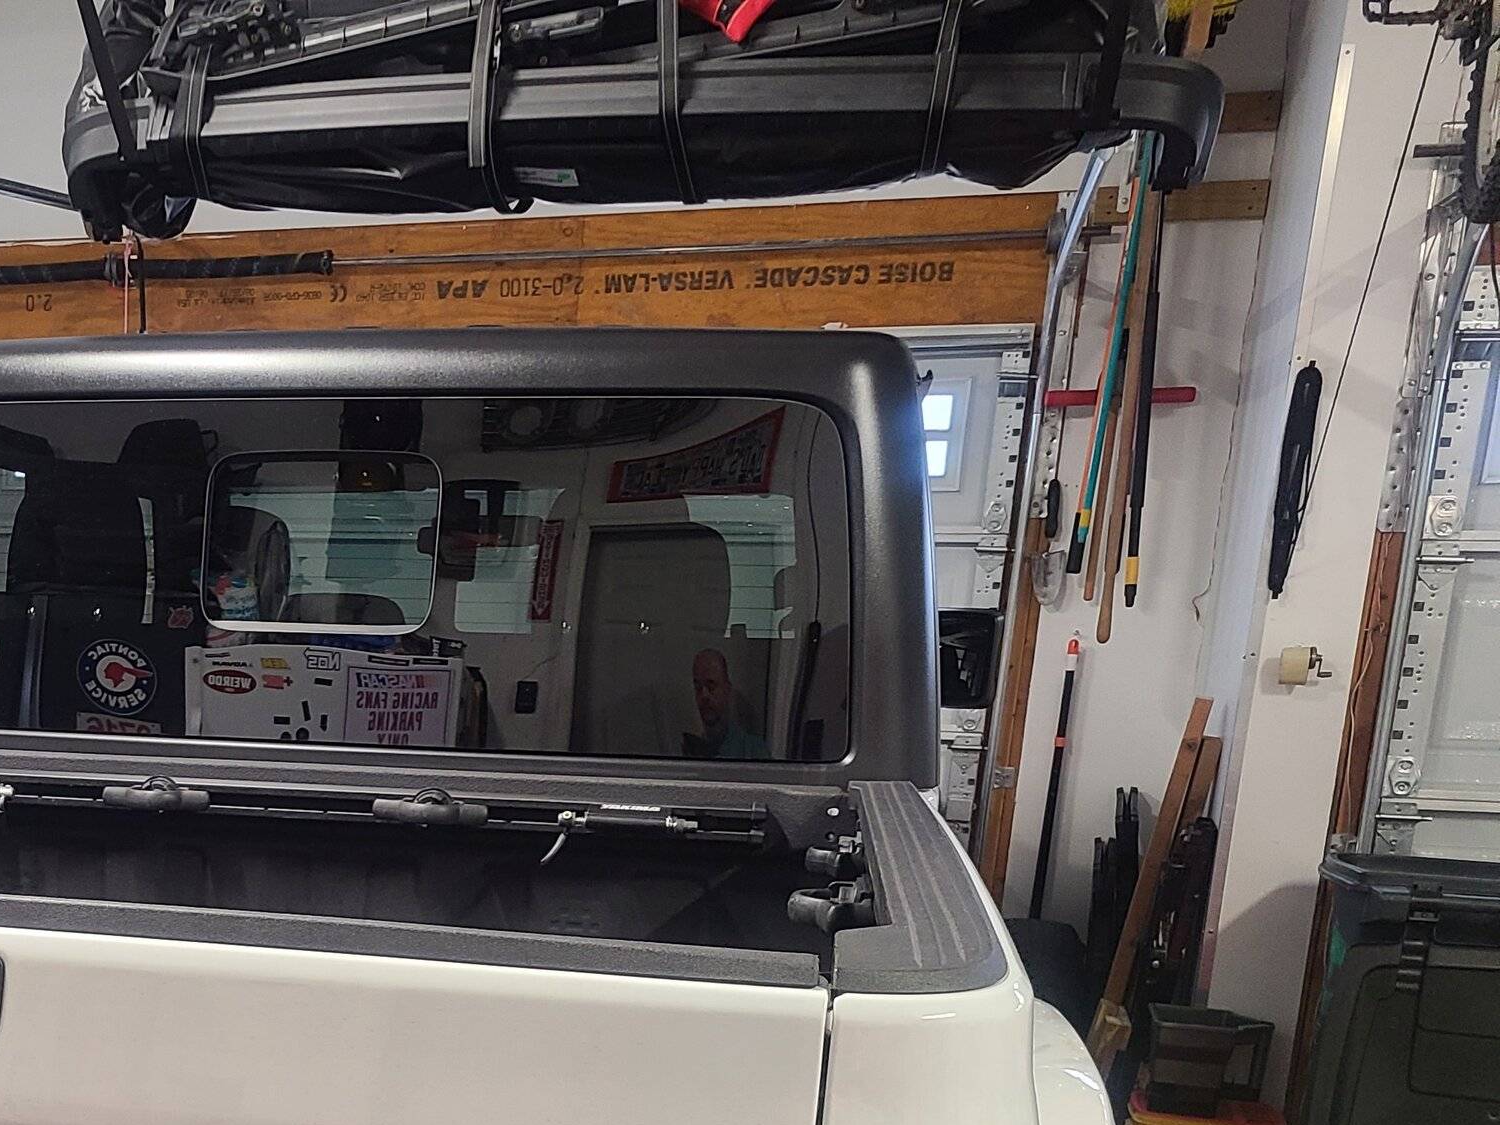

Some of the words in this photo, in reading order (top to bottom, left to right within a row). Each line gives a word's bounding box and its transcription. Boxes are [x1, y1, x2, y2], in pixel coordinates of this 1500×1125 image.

[604, 267, 734, 294] VERSA-LAM
[754, 262, 872, 289] CASCADE
[878, 259, 955, 286] BOISE
[437, 278, 489, 300] APA
[25, 294, 53, 312] 2.0
